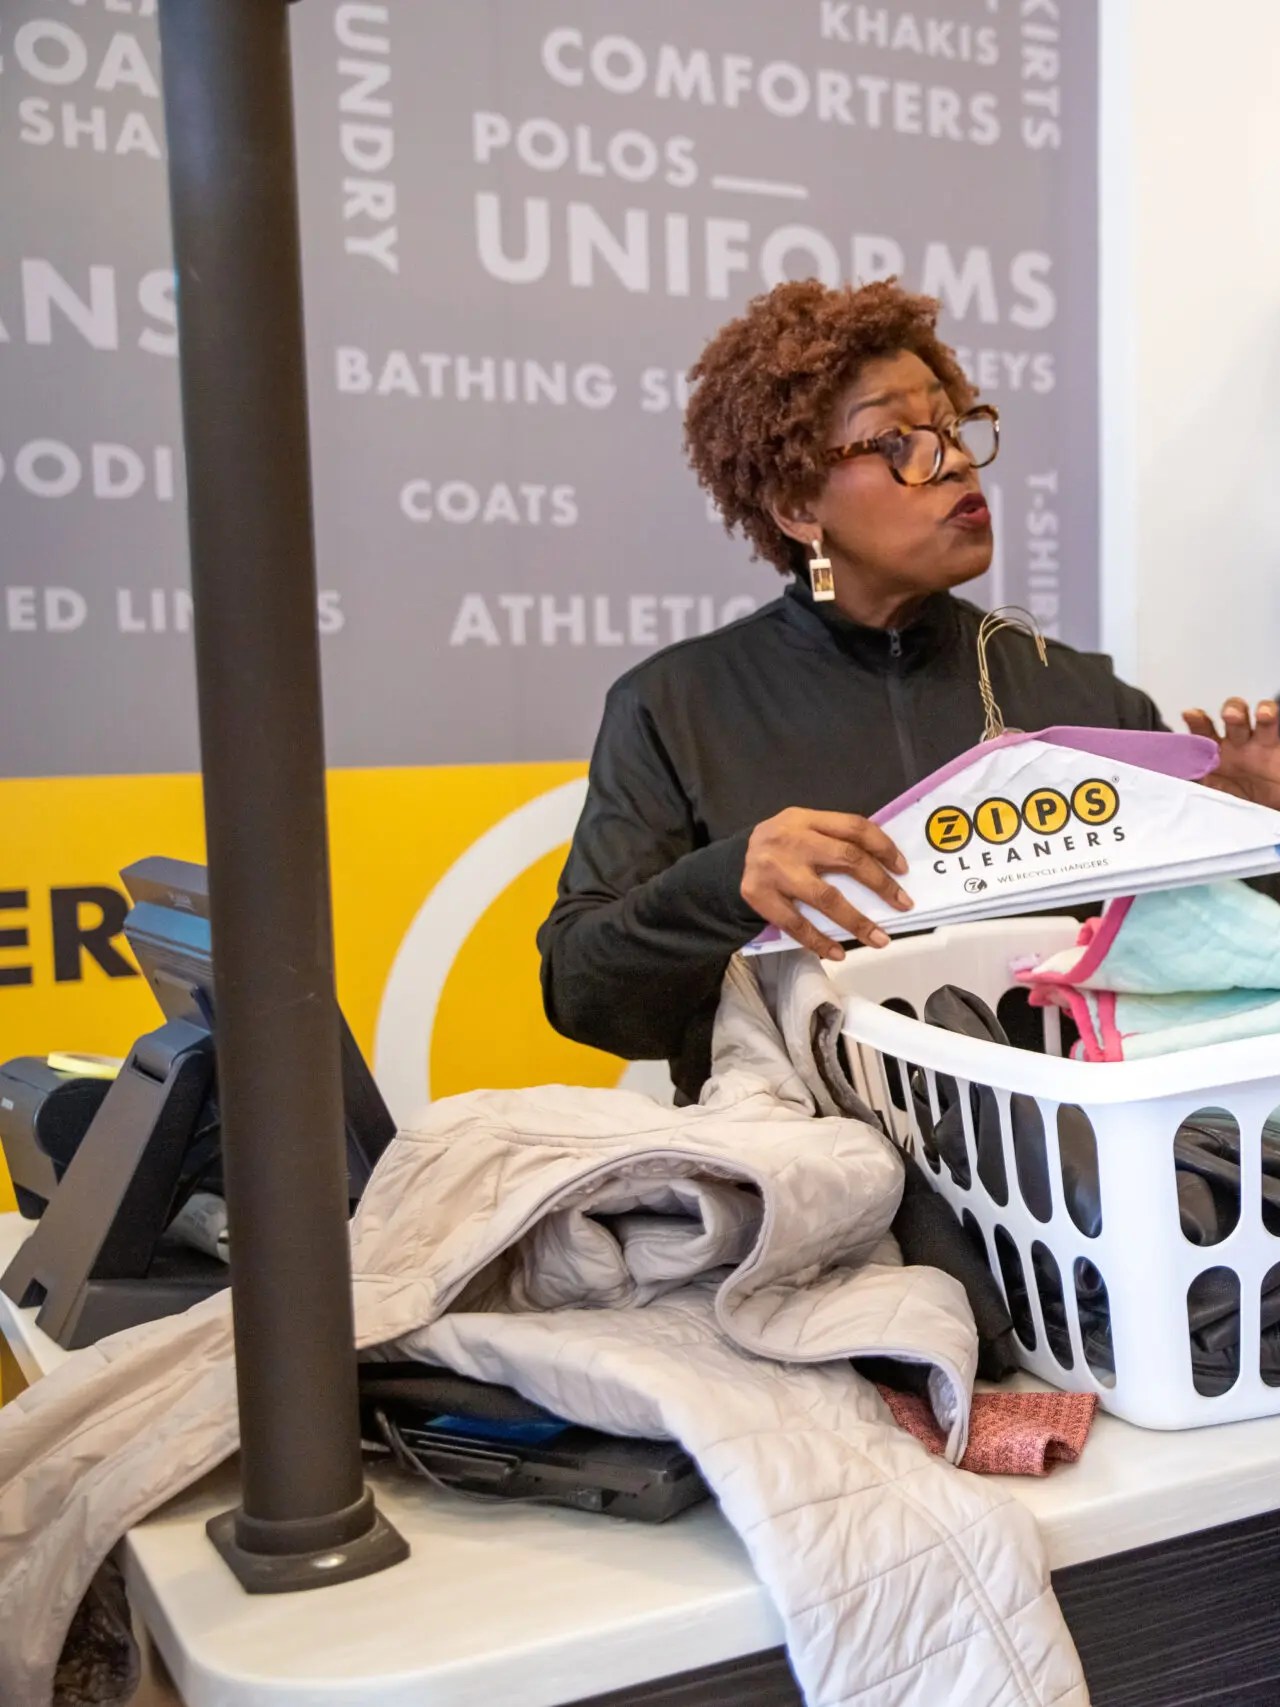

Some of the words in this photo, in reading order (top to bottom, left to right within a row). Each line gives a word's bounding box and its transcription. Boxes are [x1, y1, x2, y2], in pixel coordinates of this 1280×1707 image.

[0, 18, 161, 98] OA
[820, 0, 999, 66] KHAKIS
[541, 27, 1001, 146] COMFORTERS
[334, 4, 399, 274] UNDRY
[473, 111, 698, 187] POLOS
[0, 256, 178, 359] NS
[335, 345, 617, 410] BATHING
[0, 436, 174, 502] ODI
[400, 478, 579, 527] COATS
[5, 585, 87, 632] ED
[934, 784, 1110, 847] ZIPS
[933, 826, 1126, 875] CLEANERS
[997, 874, 1015, 885] WE
[1017, 868, 1058, 881] RECYCLE
[1060, 858, 1110, 874] HANGERS
